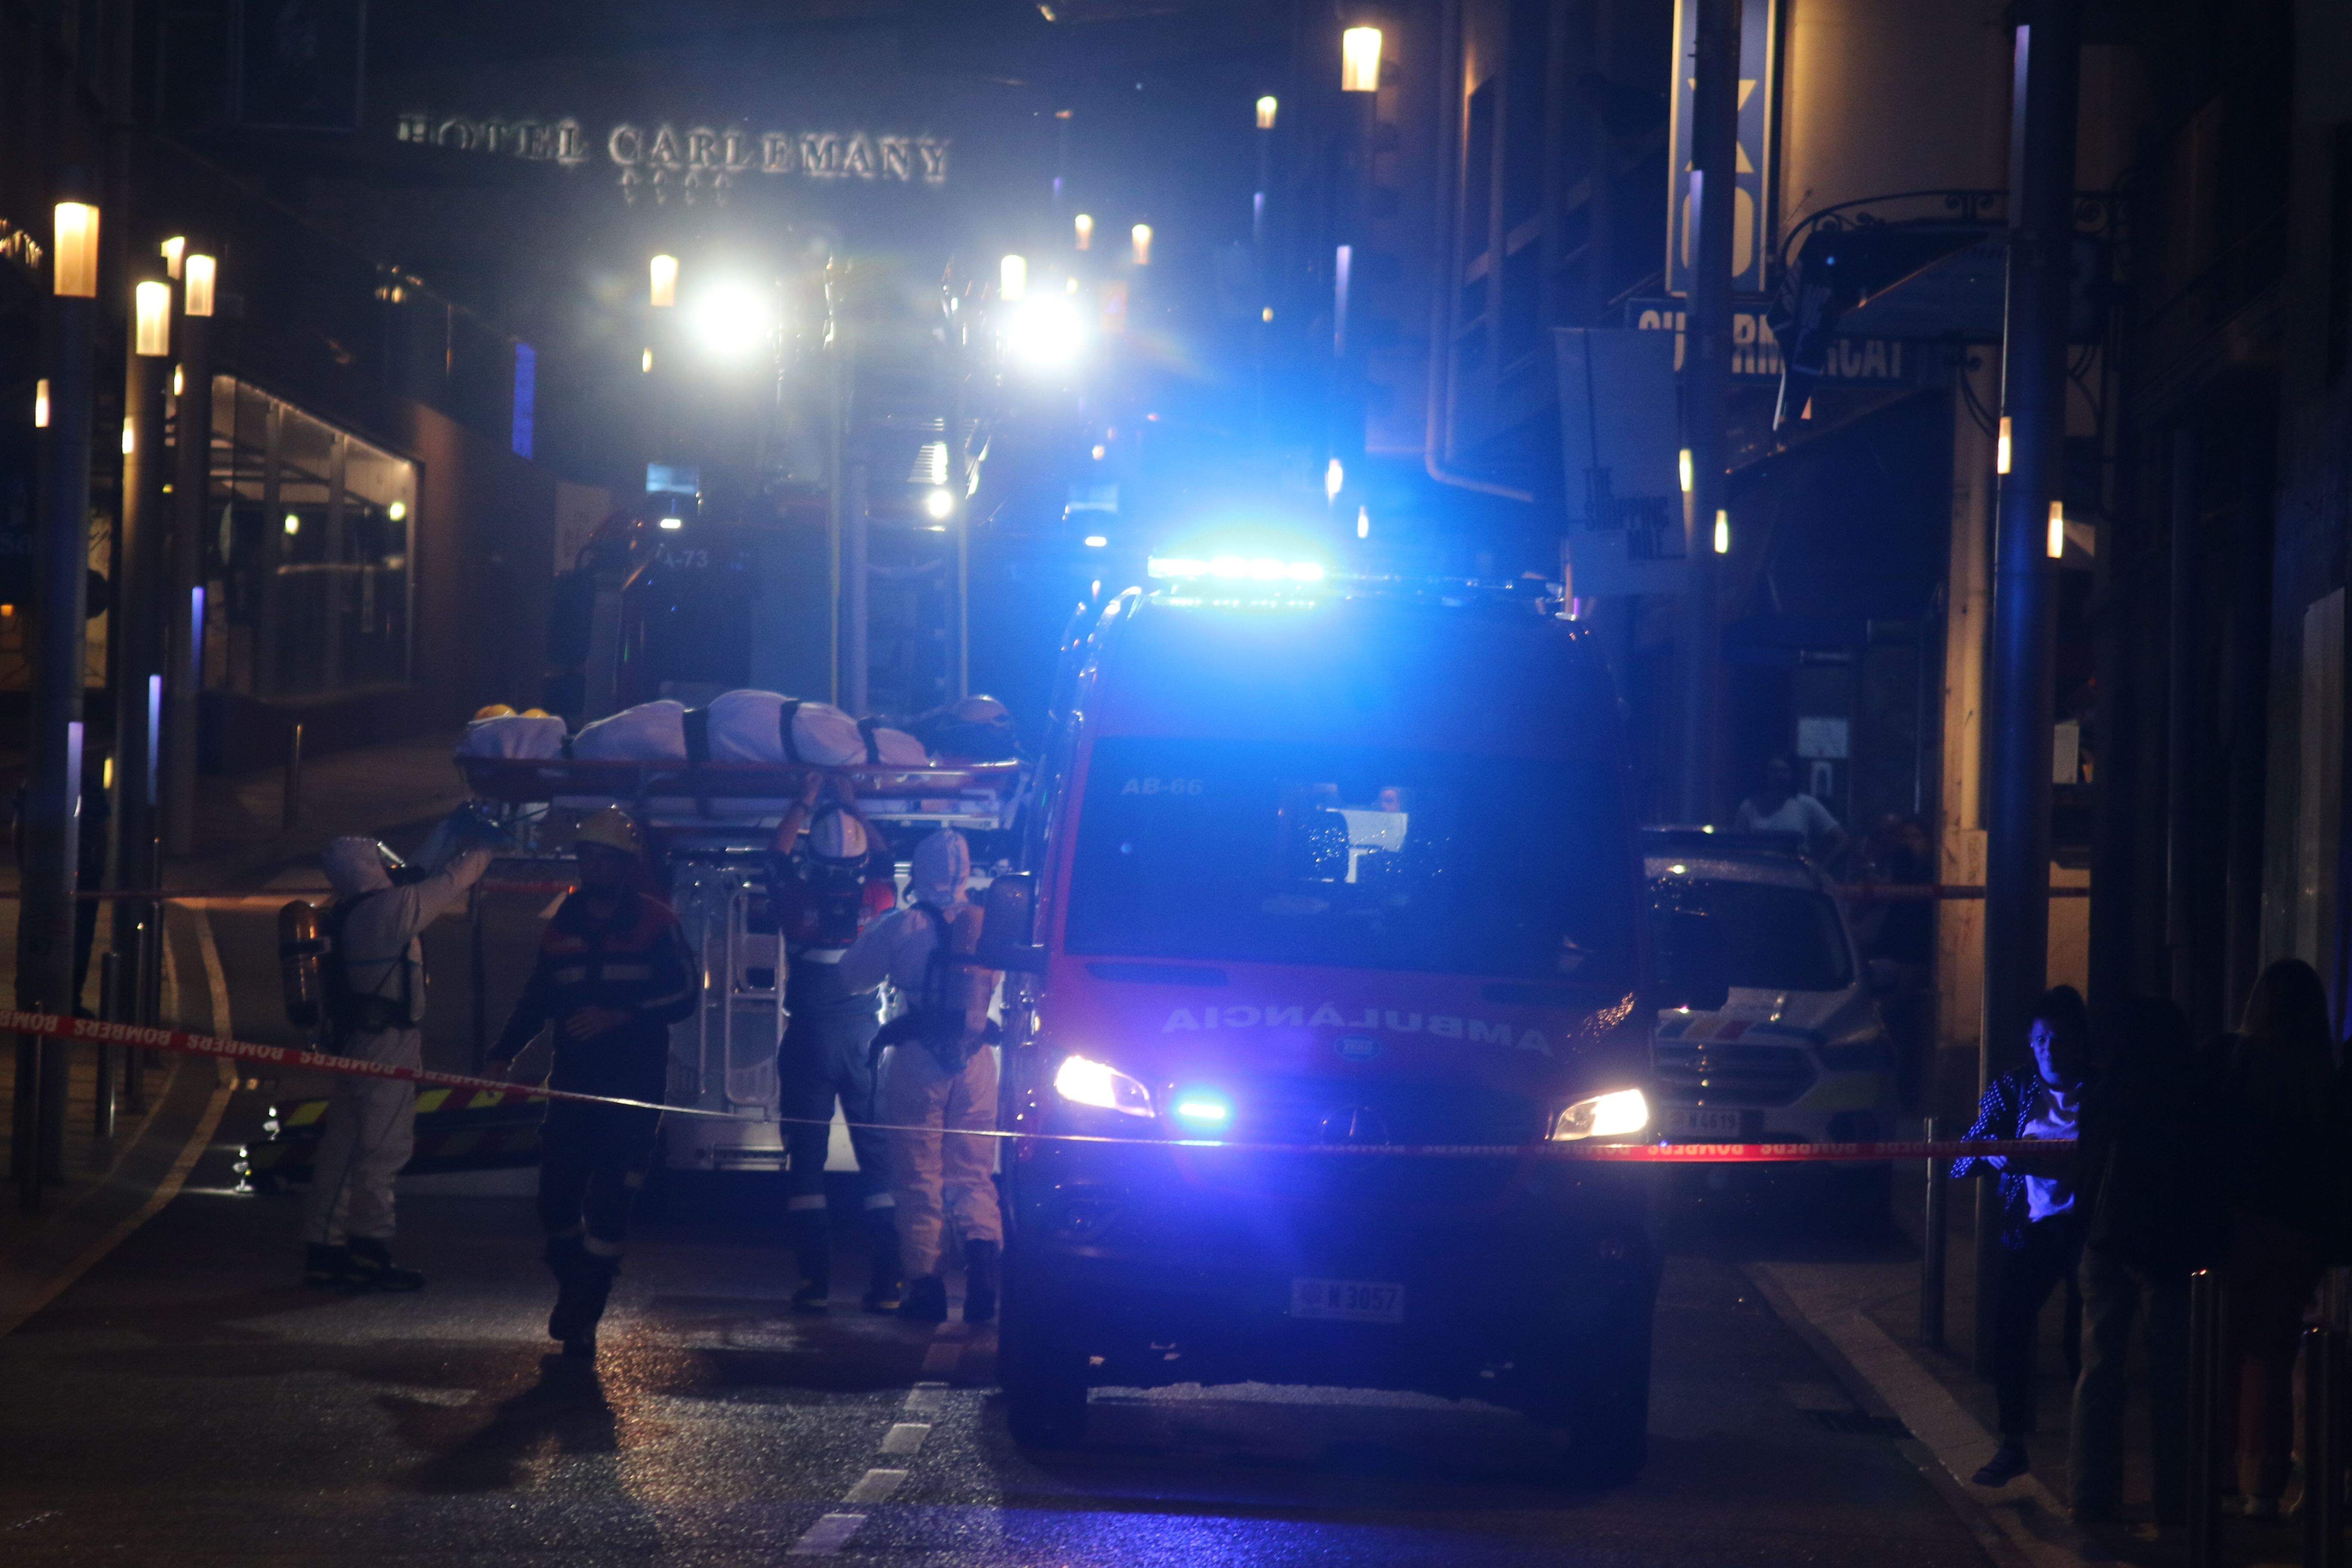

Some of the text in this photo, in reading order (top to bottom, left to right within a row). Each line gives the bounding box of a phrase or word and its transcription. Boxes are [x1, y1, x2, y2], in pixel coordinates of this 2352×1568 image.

[607, 123, 948, 182] CARLEMANY
[1120, 777, 1204, 796] AB-66
[74, 1018, 172, 1046] BOMBERS
[187, 1034, 284, 1060] BOMBERS
